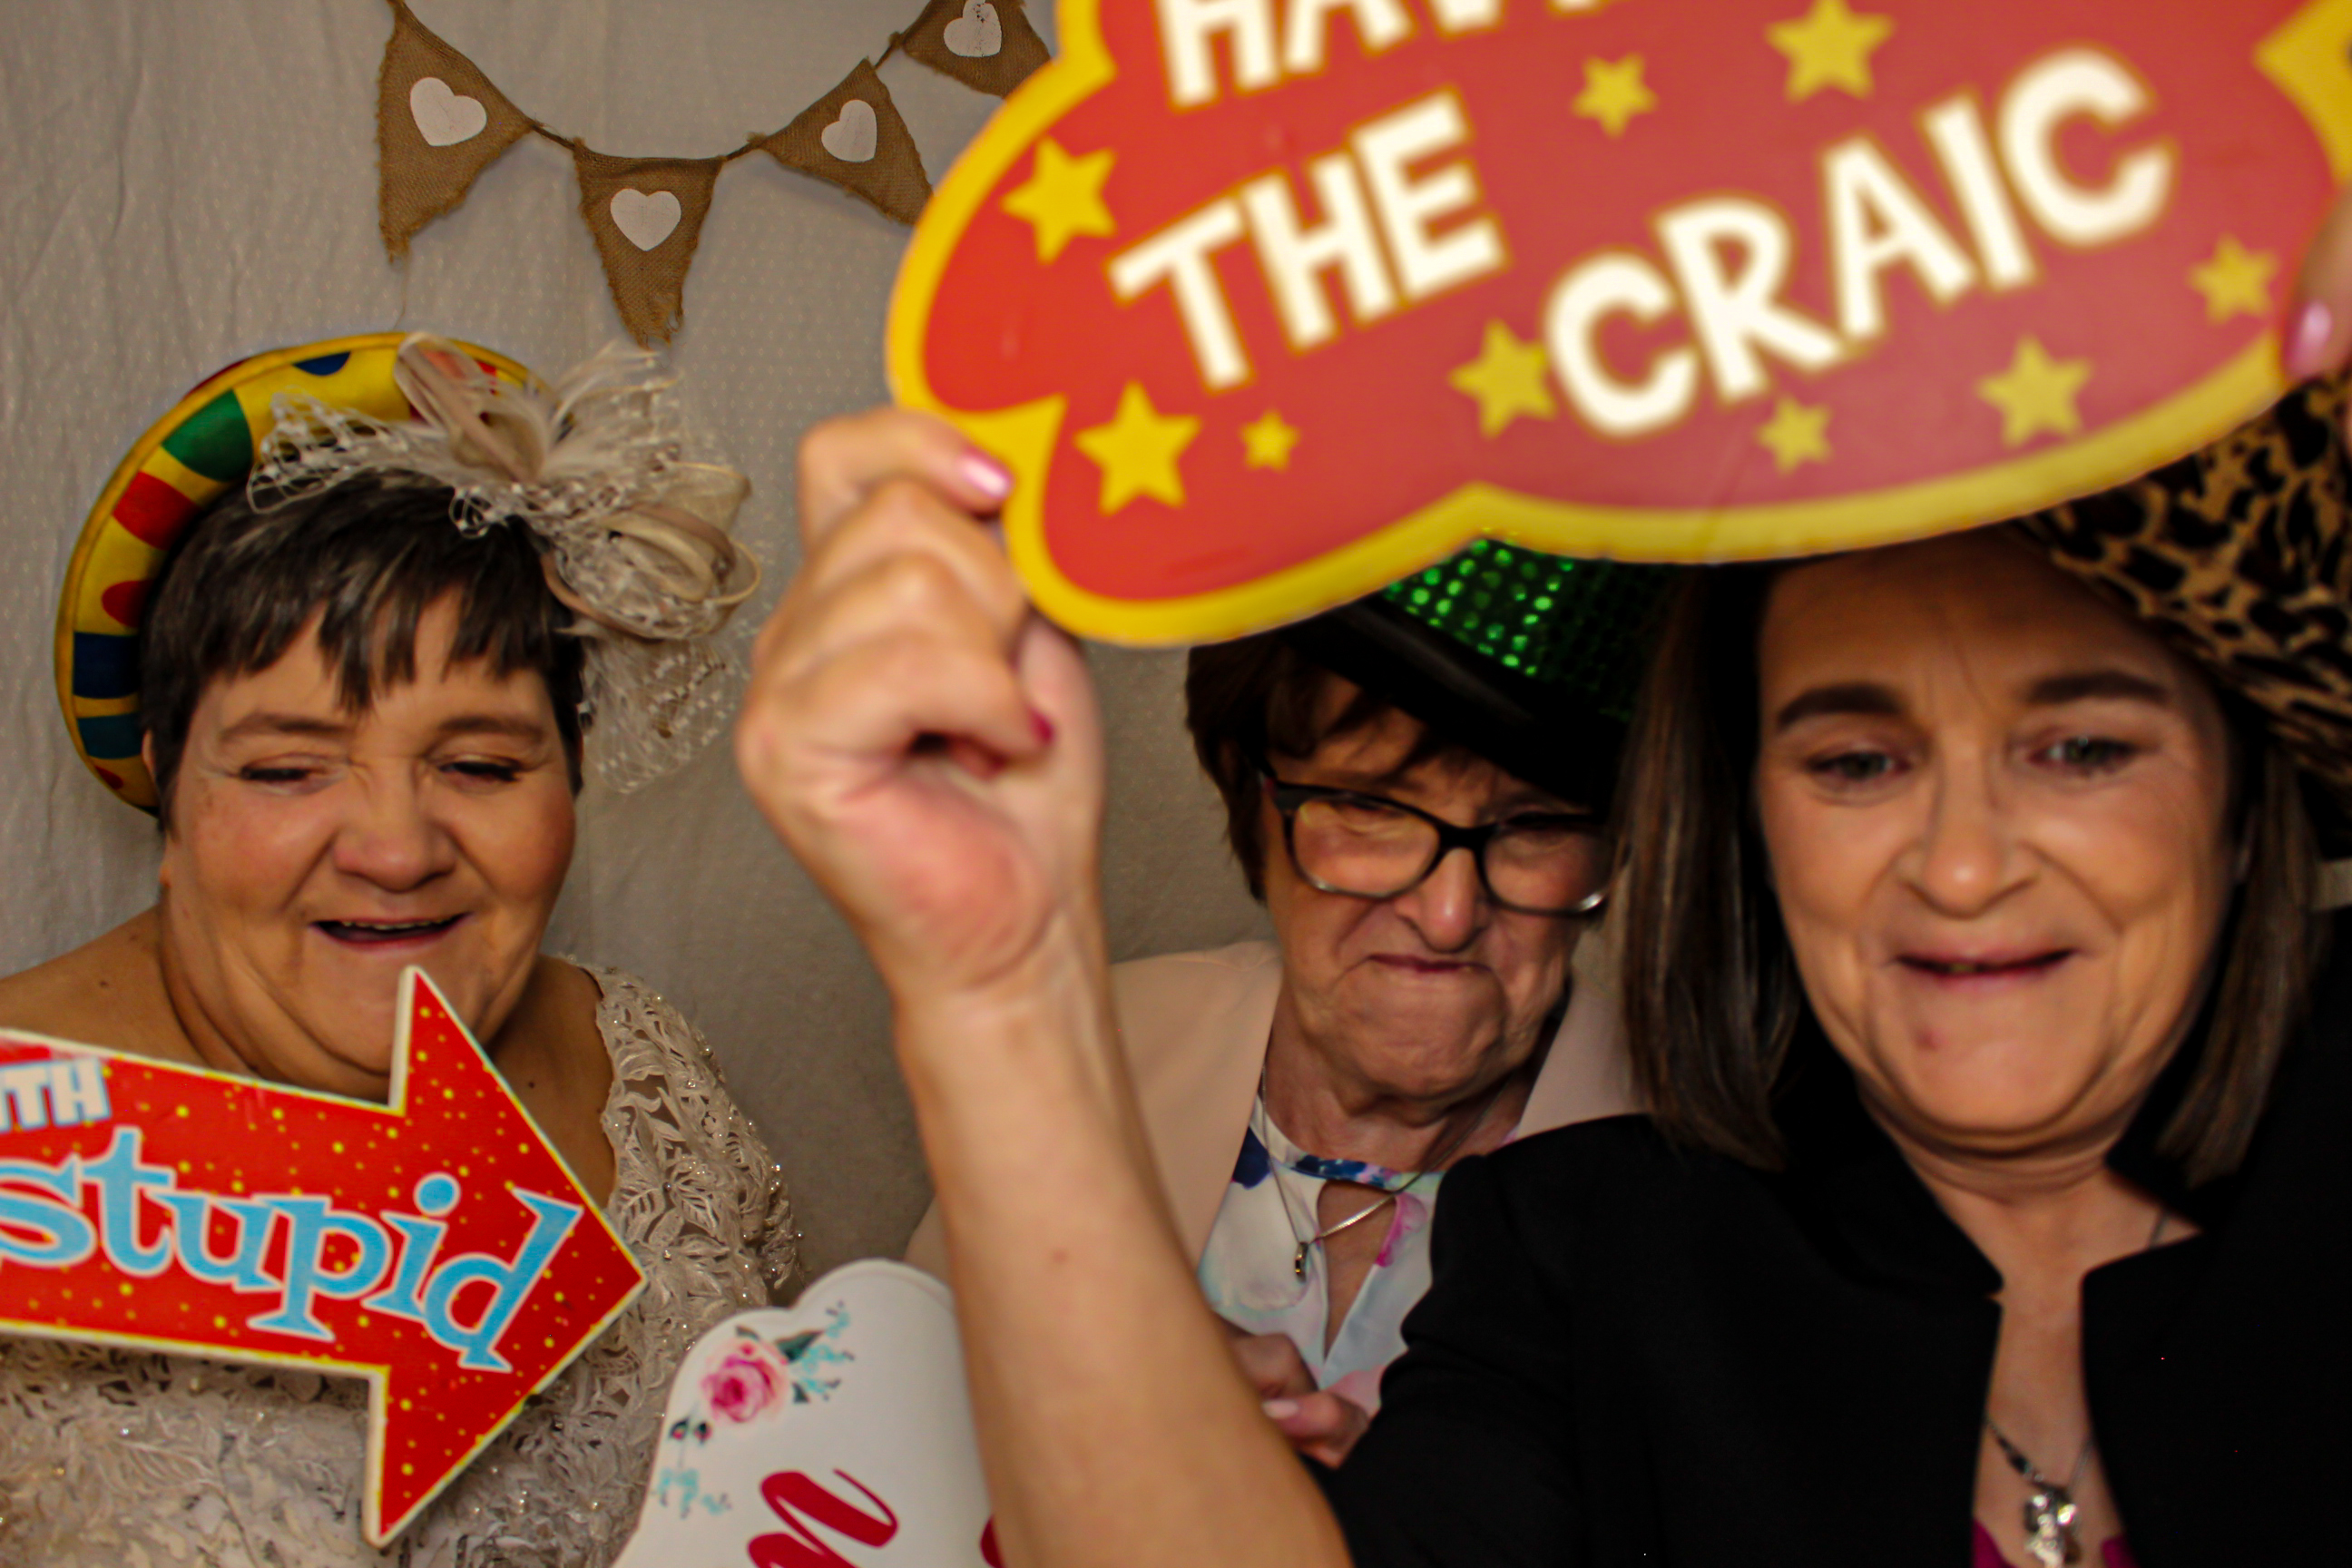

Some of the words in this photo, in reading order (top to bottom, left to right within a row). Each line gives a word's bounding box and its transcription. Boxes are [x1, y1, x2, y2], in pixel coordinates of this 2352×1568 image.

[1107, 87, 1508, 394] THE
[1544, 49, 2174, 438] CRAIC
[0, 1126, 583, 1373] stupid
